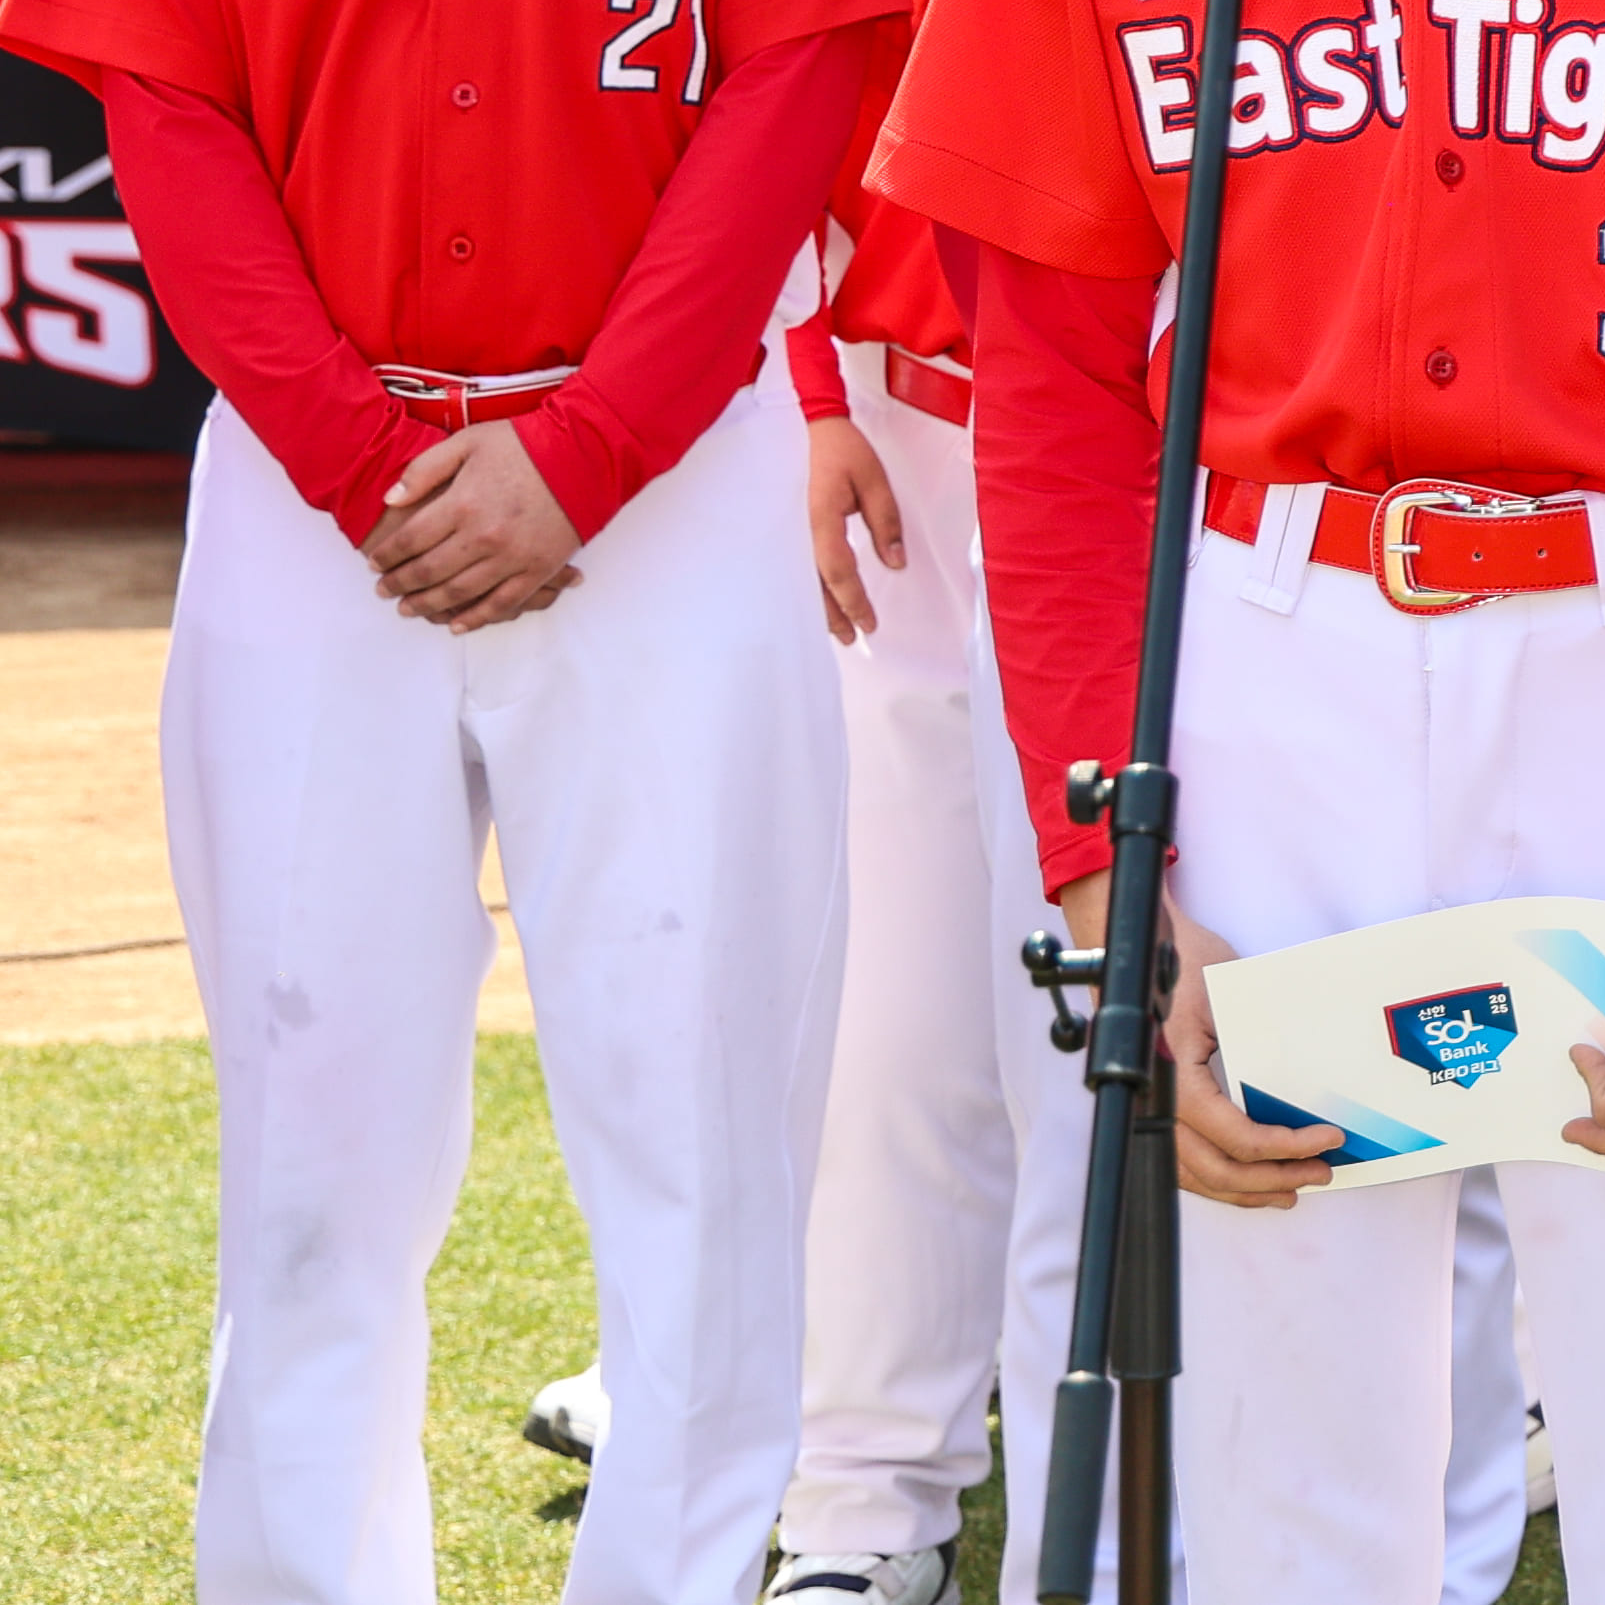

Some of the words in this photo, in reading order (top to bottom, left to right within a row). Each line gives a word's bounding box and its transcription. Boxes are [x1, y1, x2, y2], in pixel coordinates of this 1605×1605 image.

[1488, 993, 1507, 1004] 20
[1417, 1004, 1446, 1021] 신한
[1490, 1003, 1509, 1014] 25
[1439, 1040, 1491, 1062] Bank
[1432, 1065, 1469, 1084] KBO
[1470, 1059, 1500, 1074] 리그
